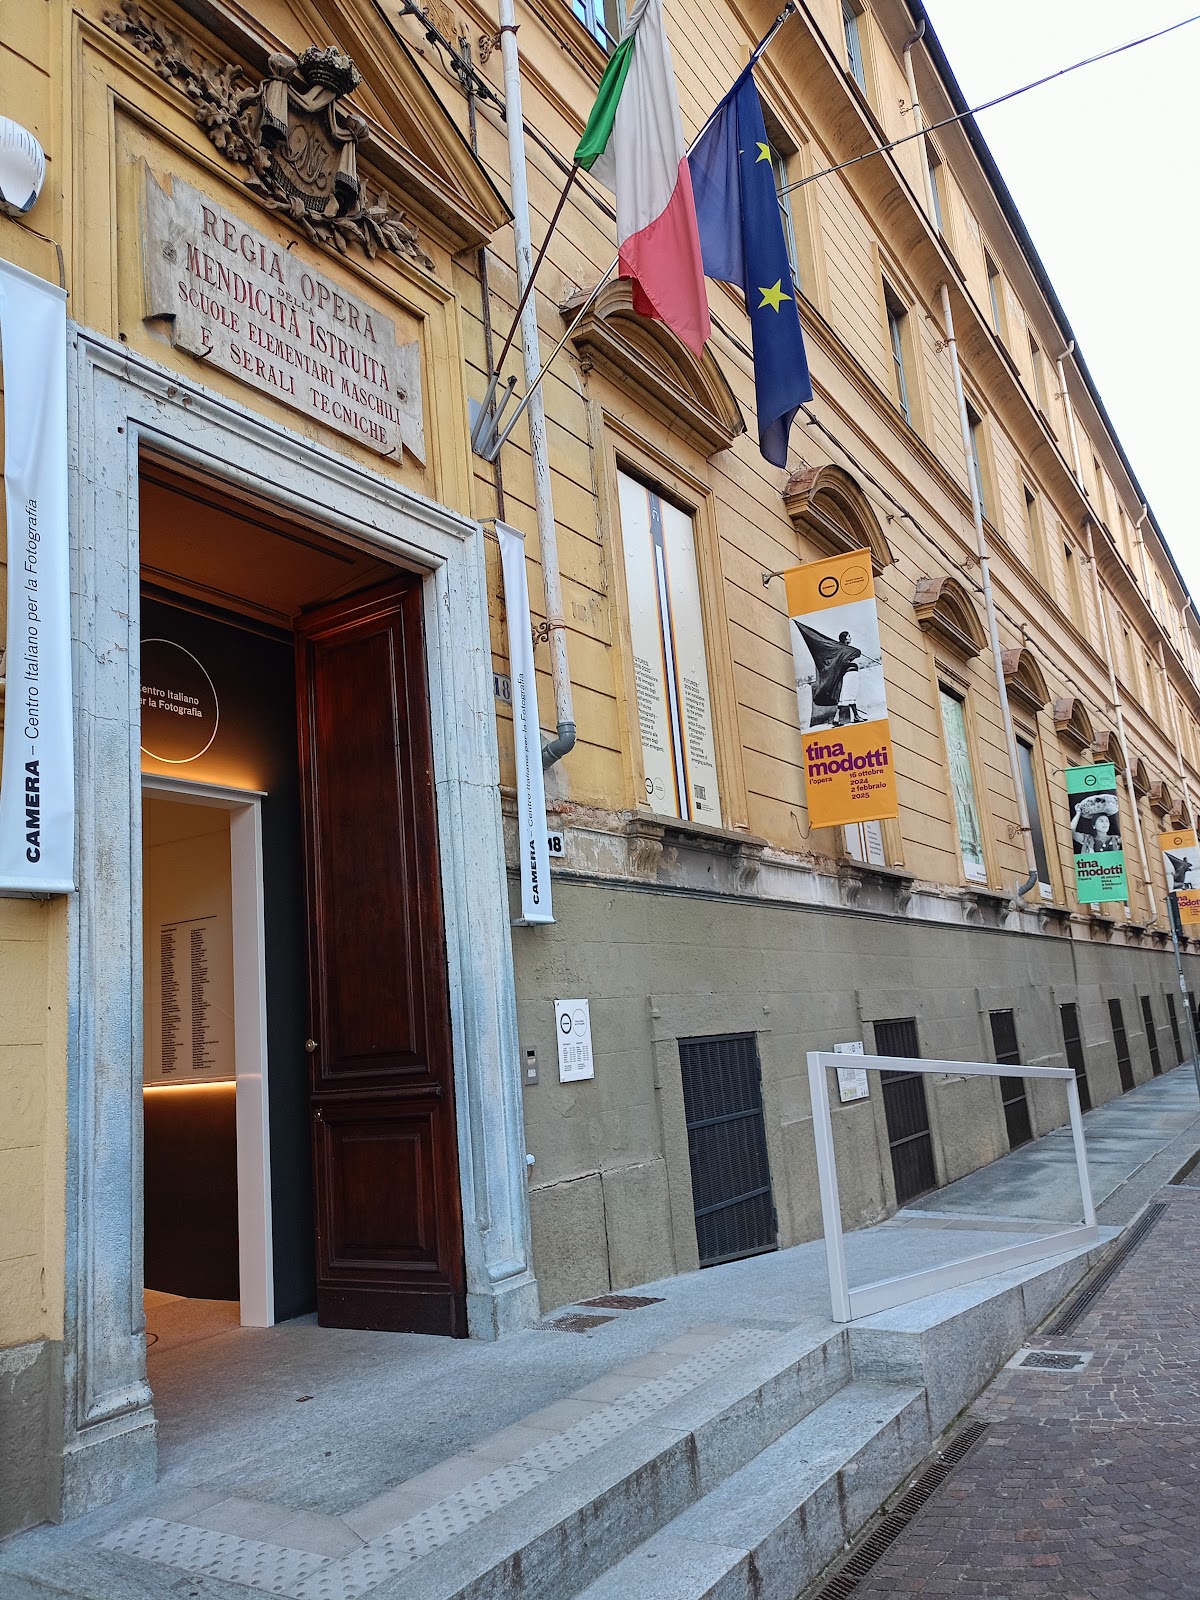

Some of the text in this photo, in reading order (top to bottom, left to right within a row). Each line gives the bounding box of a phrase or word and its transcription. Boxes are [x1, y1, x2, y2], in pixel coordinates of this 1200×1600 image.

[201, 204, 377, 343] REGIA OPERA
[277, 287, 315, 317] DELLA
[185, 242, 389, 391] MENDICITÀ ISTRUITA
[178, 281, 400, 426] SCUOLE ELEMENTARI MASCHILI
[200, 326, 388, 445] E SERALI TECNICHE
[25, 499, 41, 574] Fotografia
[25, 578, 38, 592] la
[28, 595, 42, 623] per
[24, 625, 39, 682] Italiano
[140, 684, 200, 706] entro Italiano
[494, 676, 511, 700] 18
[518, 673, 527, 722] Fotografia
[25, 686, 39, 739] Centro
[148, 697, 157, 708] la
[158, 699, 203, 718] Fotografia
[521, 725, 528, 735] la
[805, 741, 845, 762] tina
[808, 746, 889, 777] modotti
[809, 777, 833, 786] l'opera
[858, 768, 884, 777] ottobre
[850, 778, 869, 786] 2024
[856, 782, 887, 792] febbraio
[851, 792, 870, 800] 2025
[25, 760, 41, 863] CAMERA
[548, 836, 562, 852] 18
[529, 839, 540, 905] CAMERA
[1076, 859, 1099, 869] tina
[1077, 864, 1123, 877] modotti
